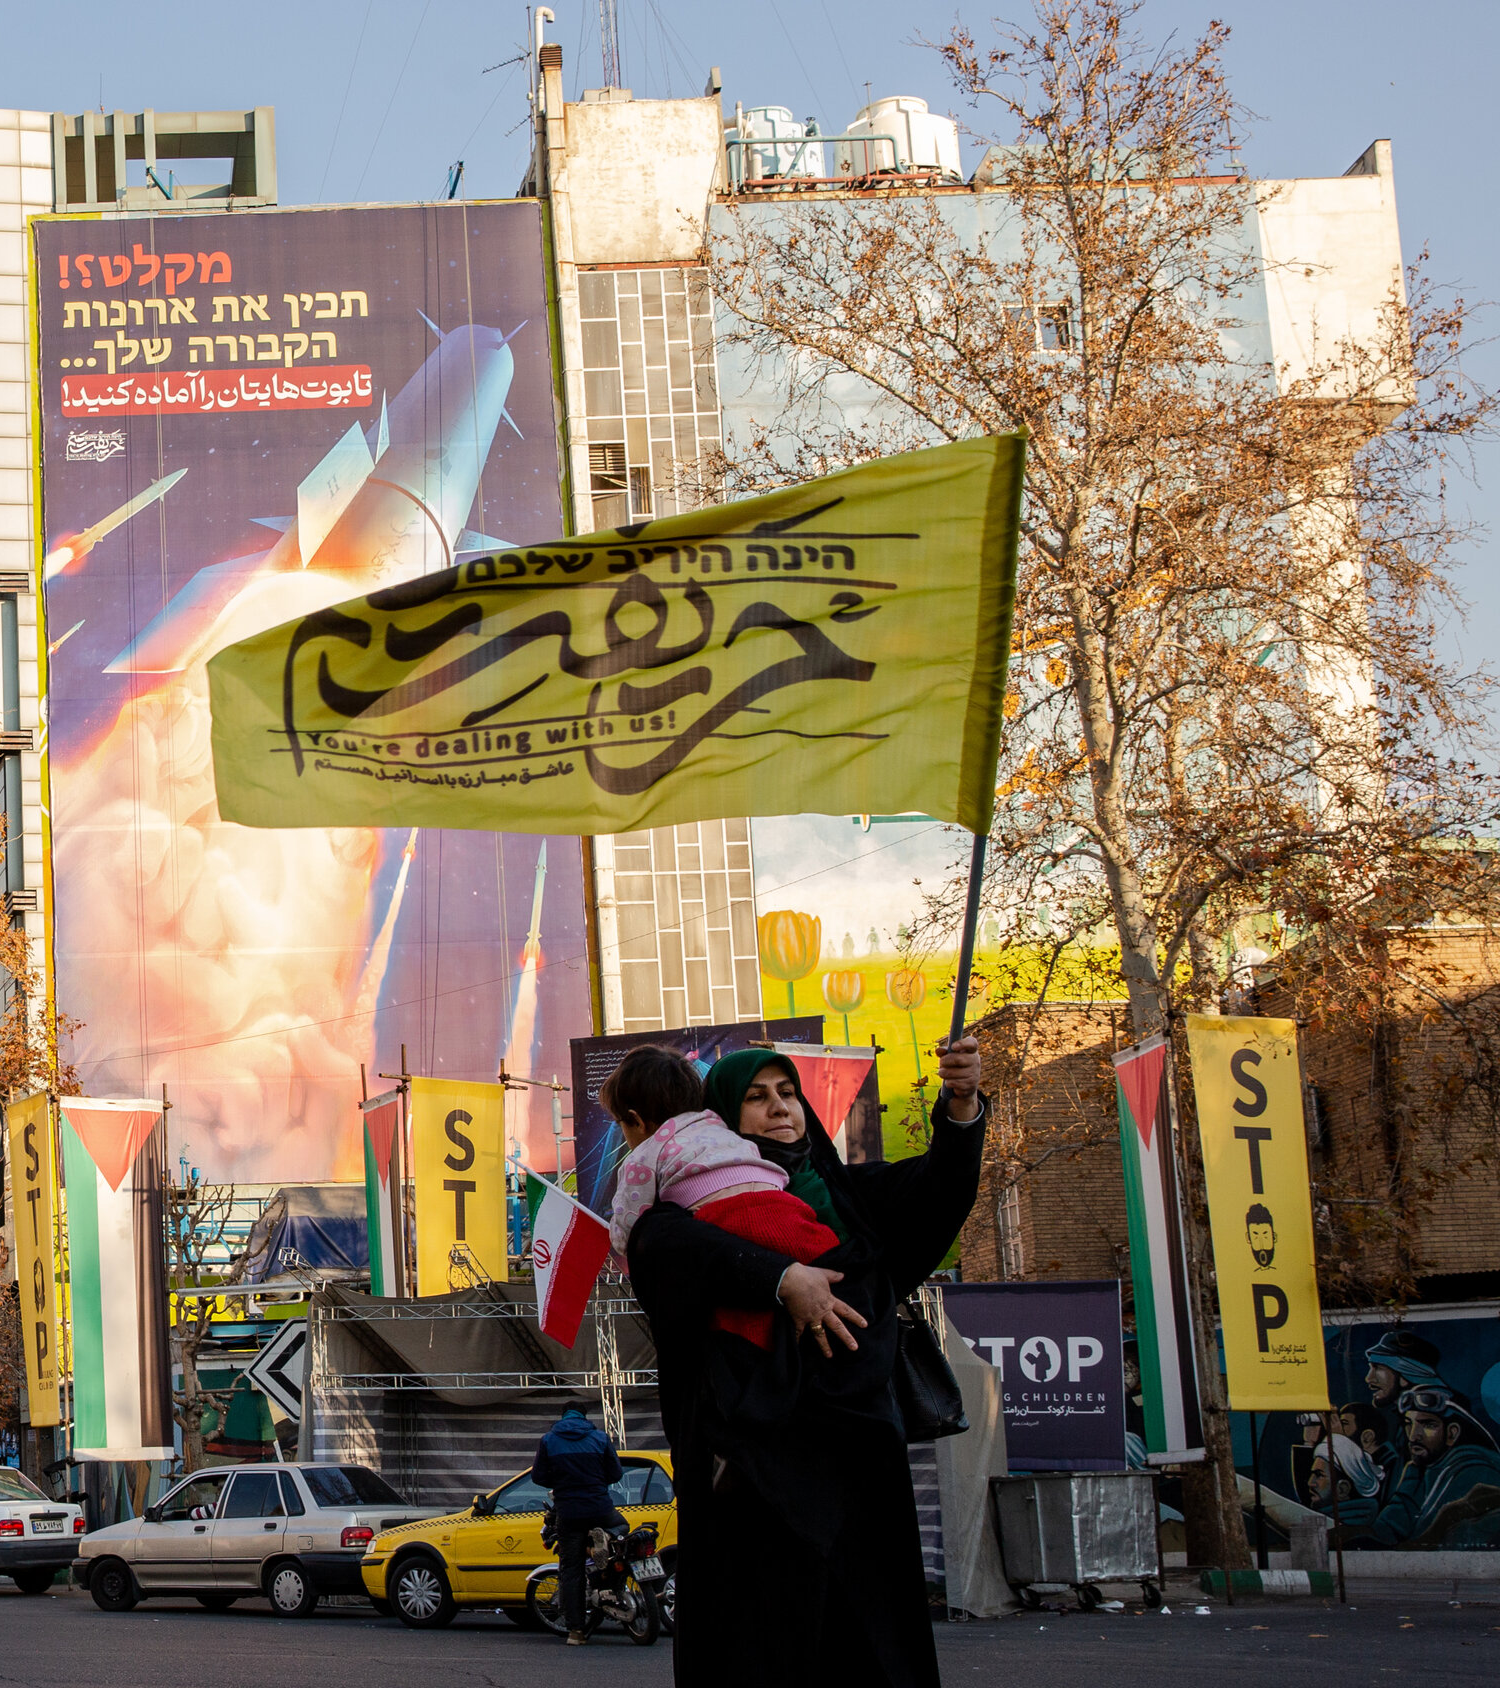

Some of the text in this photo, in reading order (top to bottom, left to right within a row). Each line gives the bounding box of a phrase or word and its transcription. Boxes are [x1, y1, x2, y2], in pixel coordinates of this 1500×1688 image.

[63, 291, 369, 329] תכין את ארונות
[188, 331, 338, 368] הקבורה
[61, 378, 135, 413] کنید!
[135, 370, 200, 405] آماده
[466, 544, 855, 583] הינה היריב שלכם
[306, 709, 676, 759] You're dealing with us!
[962, 1336, 1104, 1382] TOP
[1021, 1393, 1105, 1401] CHILDREN
[1064, 1405, 1106, 1416] کشتار
